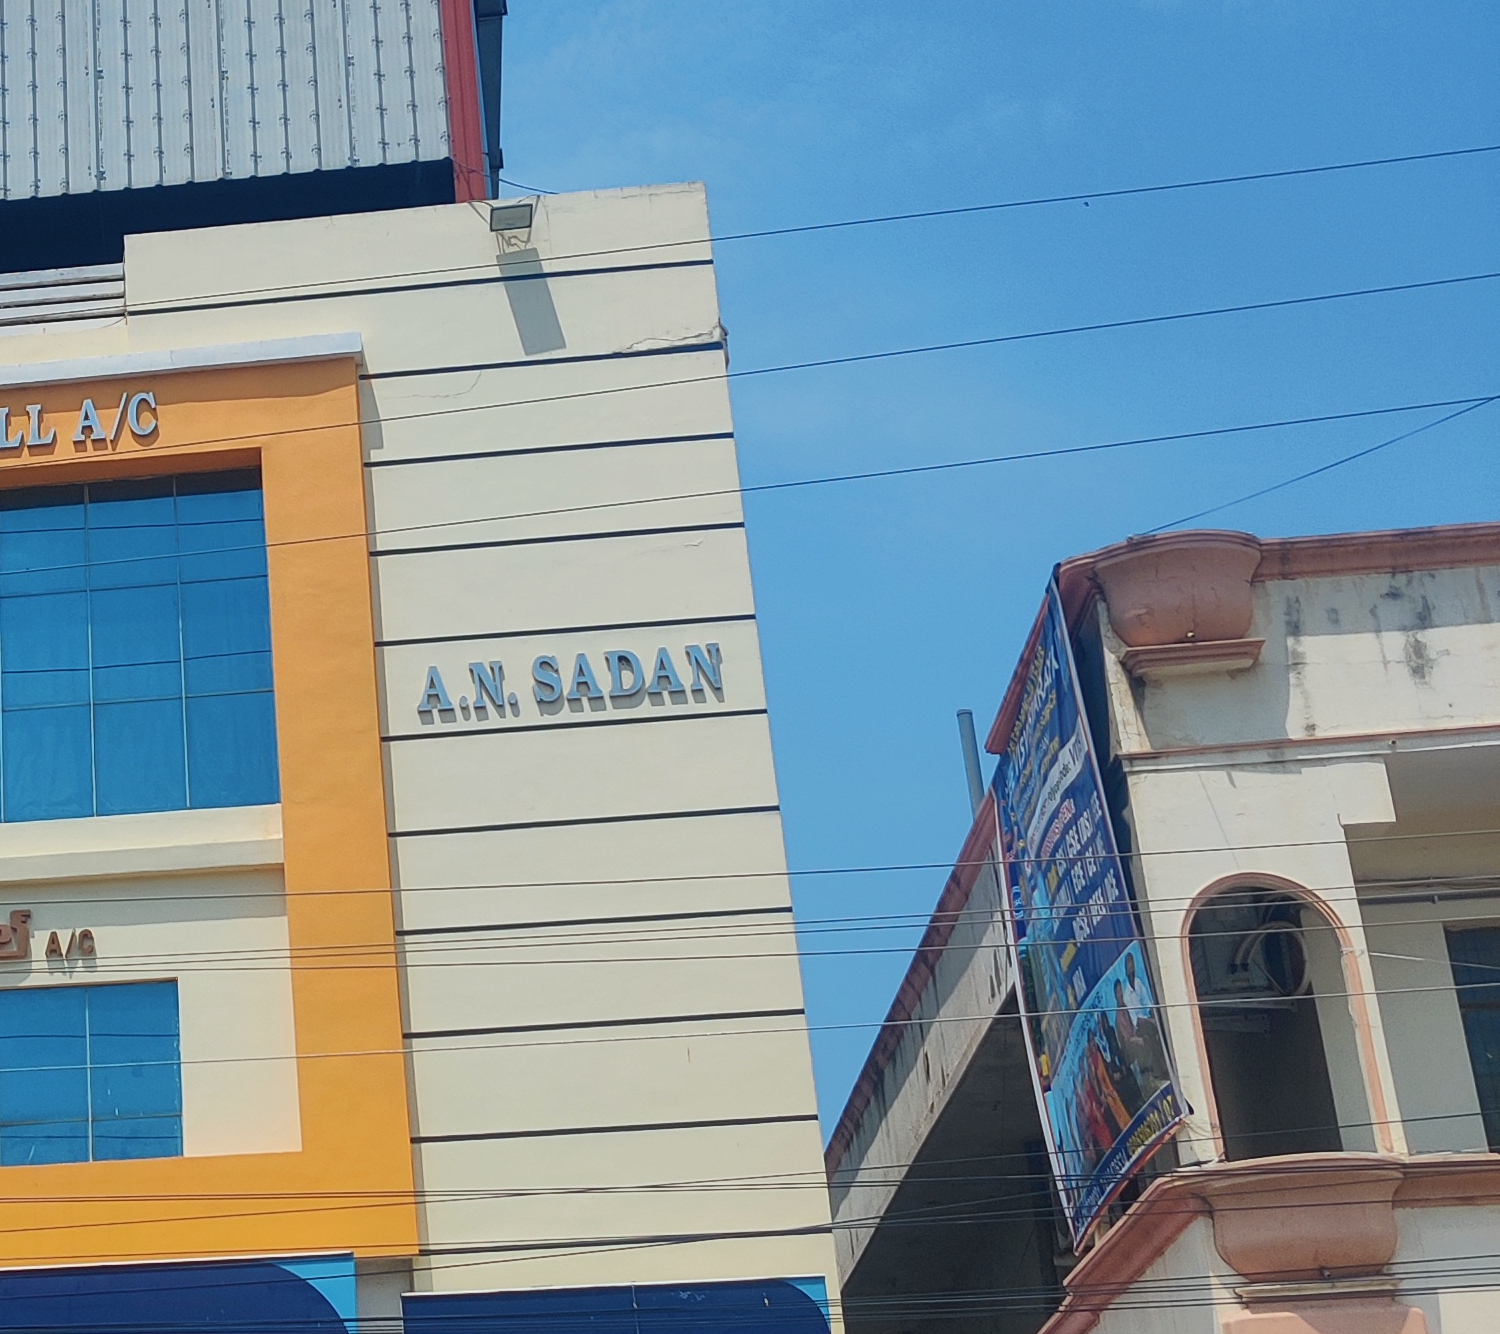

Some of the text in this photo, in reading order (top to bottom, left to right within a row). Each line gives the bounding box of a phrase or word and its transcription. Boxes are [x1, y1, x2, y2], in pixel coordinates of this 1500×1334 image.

[72, 392, 159, 442] A/C
[532, 643, 724, 703] SADAN
[45, 928, 94, 959] A/C
